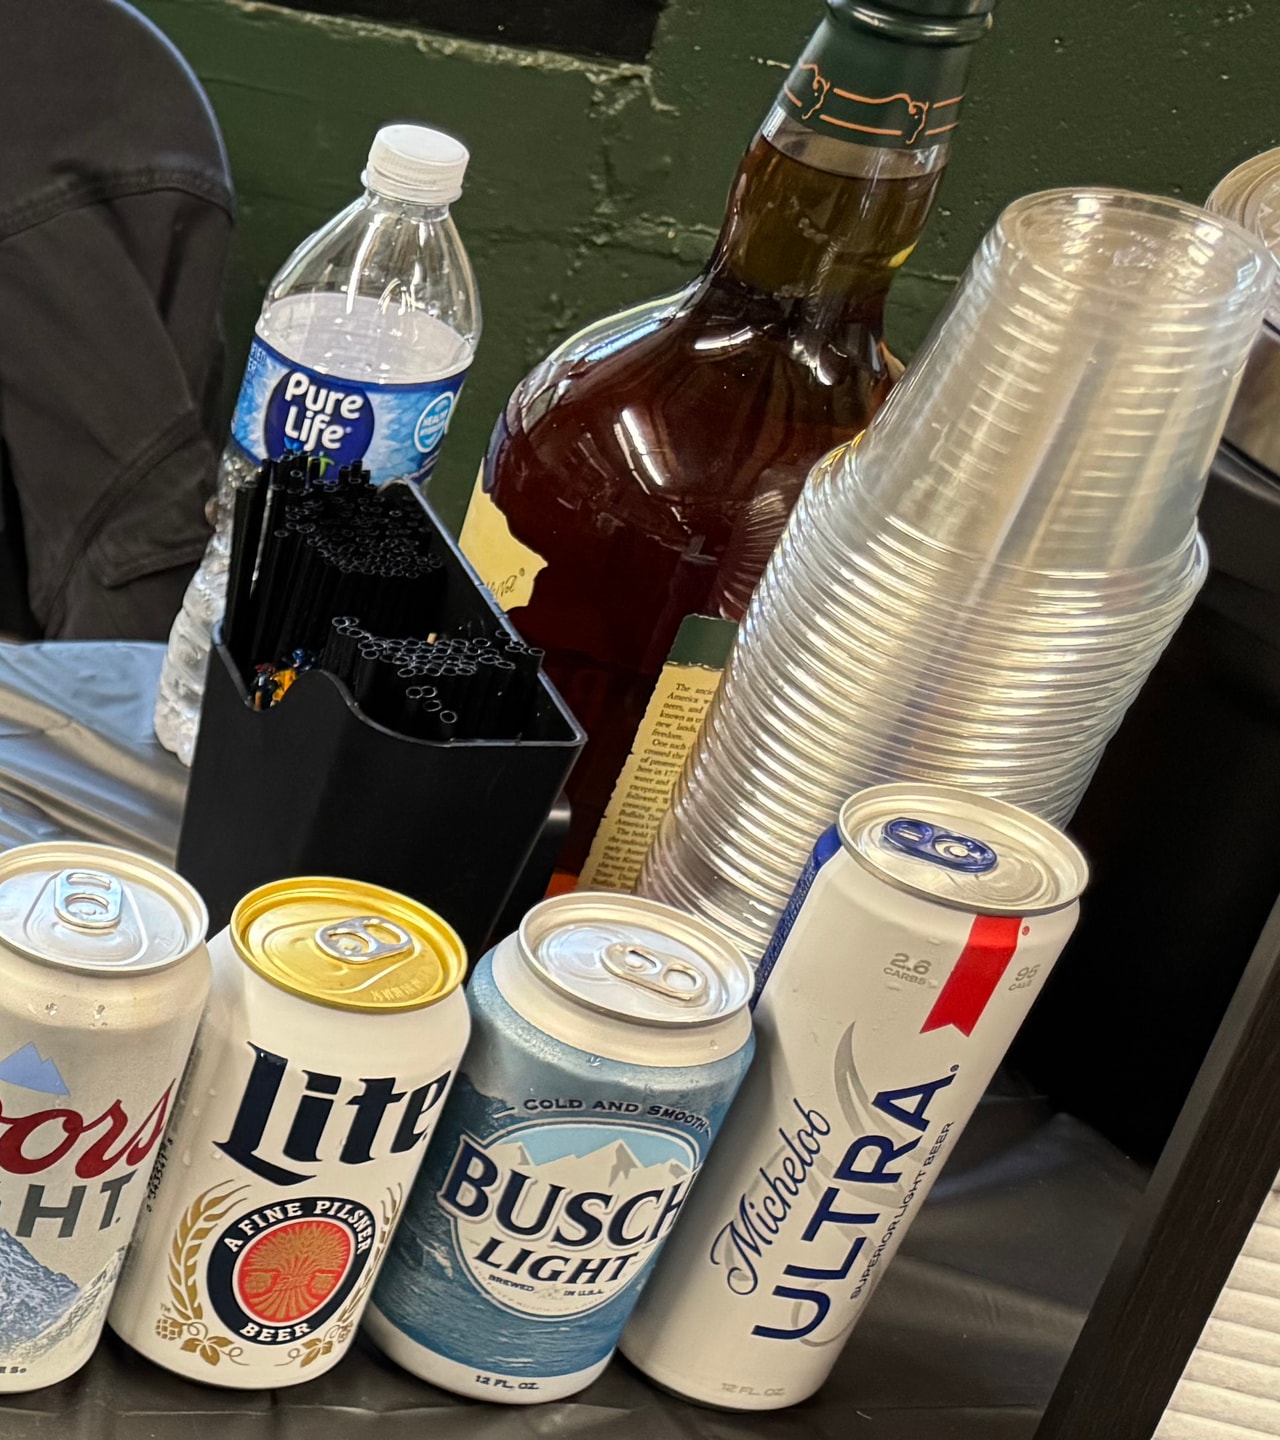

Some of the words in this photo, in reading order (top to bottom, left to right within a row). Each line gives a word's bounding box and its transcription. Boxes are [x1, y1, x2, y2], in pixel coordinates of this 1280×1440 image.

[284, 371, 364, 420] Pure
[284, 405, 345, 452] Life
[883, 967, 927, 985] CARBS
[890, 953, 932, 976] 2.6
[1014, 963, 1041, 982] 95
[212, 1041, 452, 1187] Lite
[524, 1098, 583, 1111] COLD
[592, 1100, 640, 1114] AND
[647, 1104, 709, 1134] SMOOTH
[442, 1136, 690, 1248] BUSCH
[710, 1098, 831, 1296] Michelob
[751, 1072, 957, 1340] ULTRA
[850, 1217, 901, 1301] SUPERIOR
[894, 1169, 927, 1221] LIGHT
[923, 1120, 955, 1168] BEER
[238, 1202, 303, 1236] FINE
[313, 1200, 374, 1255] PILSNER
[224, 1236, 244, 1253] A
[474, 1236, 641, 1285] LIGHT
[239, 1322, 313, 1342] BEER
[475, 1375, 490, 1385] 12
